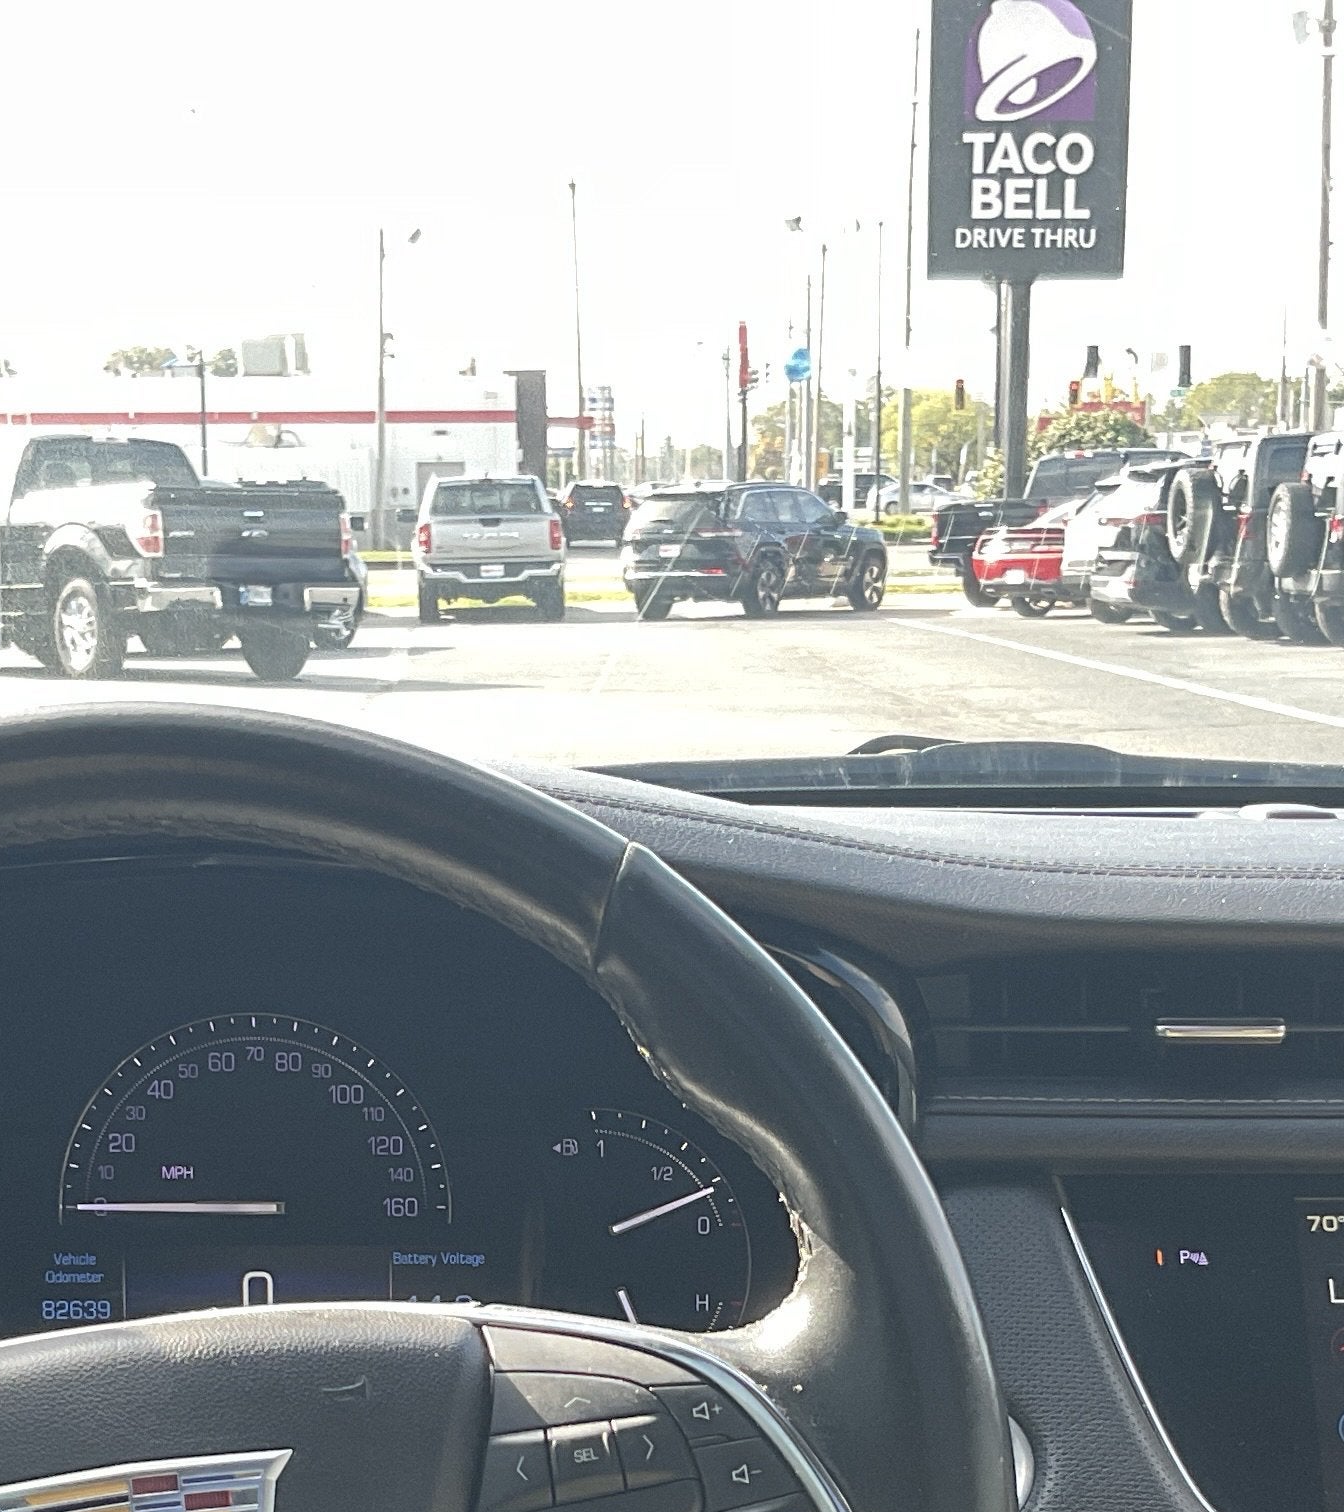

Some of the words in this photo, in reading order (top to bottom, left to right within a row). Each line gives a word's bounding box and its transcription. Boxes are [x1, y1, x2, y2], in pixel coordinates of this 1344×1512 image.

[962, 132, 1095, 175] TACO
[971, 179, 1091, 221] BELL
[954, 228, 1026, 249] DRIVE
[1031, 228, 1097, 249] THRU
[207, 1052, 236, 1072] 60
[245, 1046, 265, 1062] 70
[275, 1052, 302, 1072] 80
[178, 1064, 199, 1079] 50
[311, 1063, 332, 1079] 90
[146, 1079, 174, 1100] 40
[328, 1084, 364, 1105] 100
[125, 1105, 146, 1121] 30
[362, 1106, 385, 1122] 110
[108, 1133, 136, 1153] 20
[367, 1135, 404, 1156] 120
[97, 1164, 115, 1180] 10
[161, 1165, 194, 1180] MPH
[387, 1167, 414, 1183] 140
[650, 1166, 673, 1182] 1/2
[382, 1197, 419, 1218] 160
[53, 1252, 97, 1267] Vehicle
[392, 1251, 437, 1267] Battery
[440, 1251, 486, 1268] Voltage
[44, 1270, 105, 1285] Odometer
[41, 1299, 112, 1321] 82639
[695, 1293, 710, 1312] H
[573, 1448, 599, 1464] SEL
